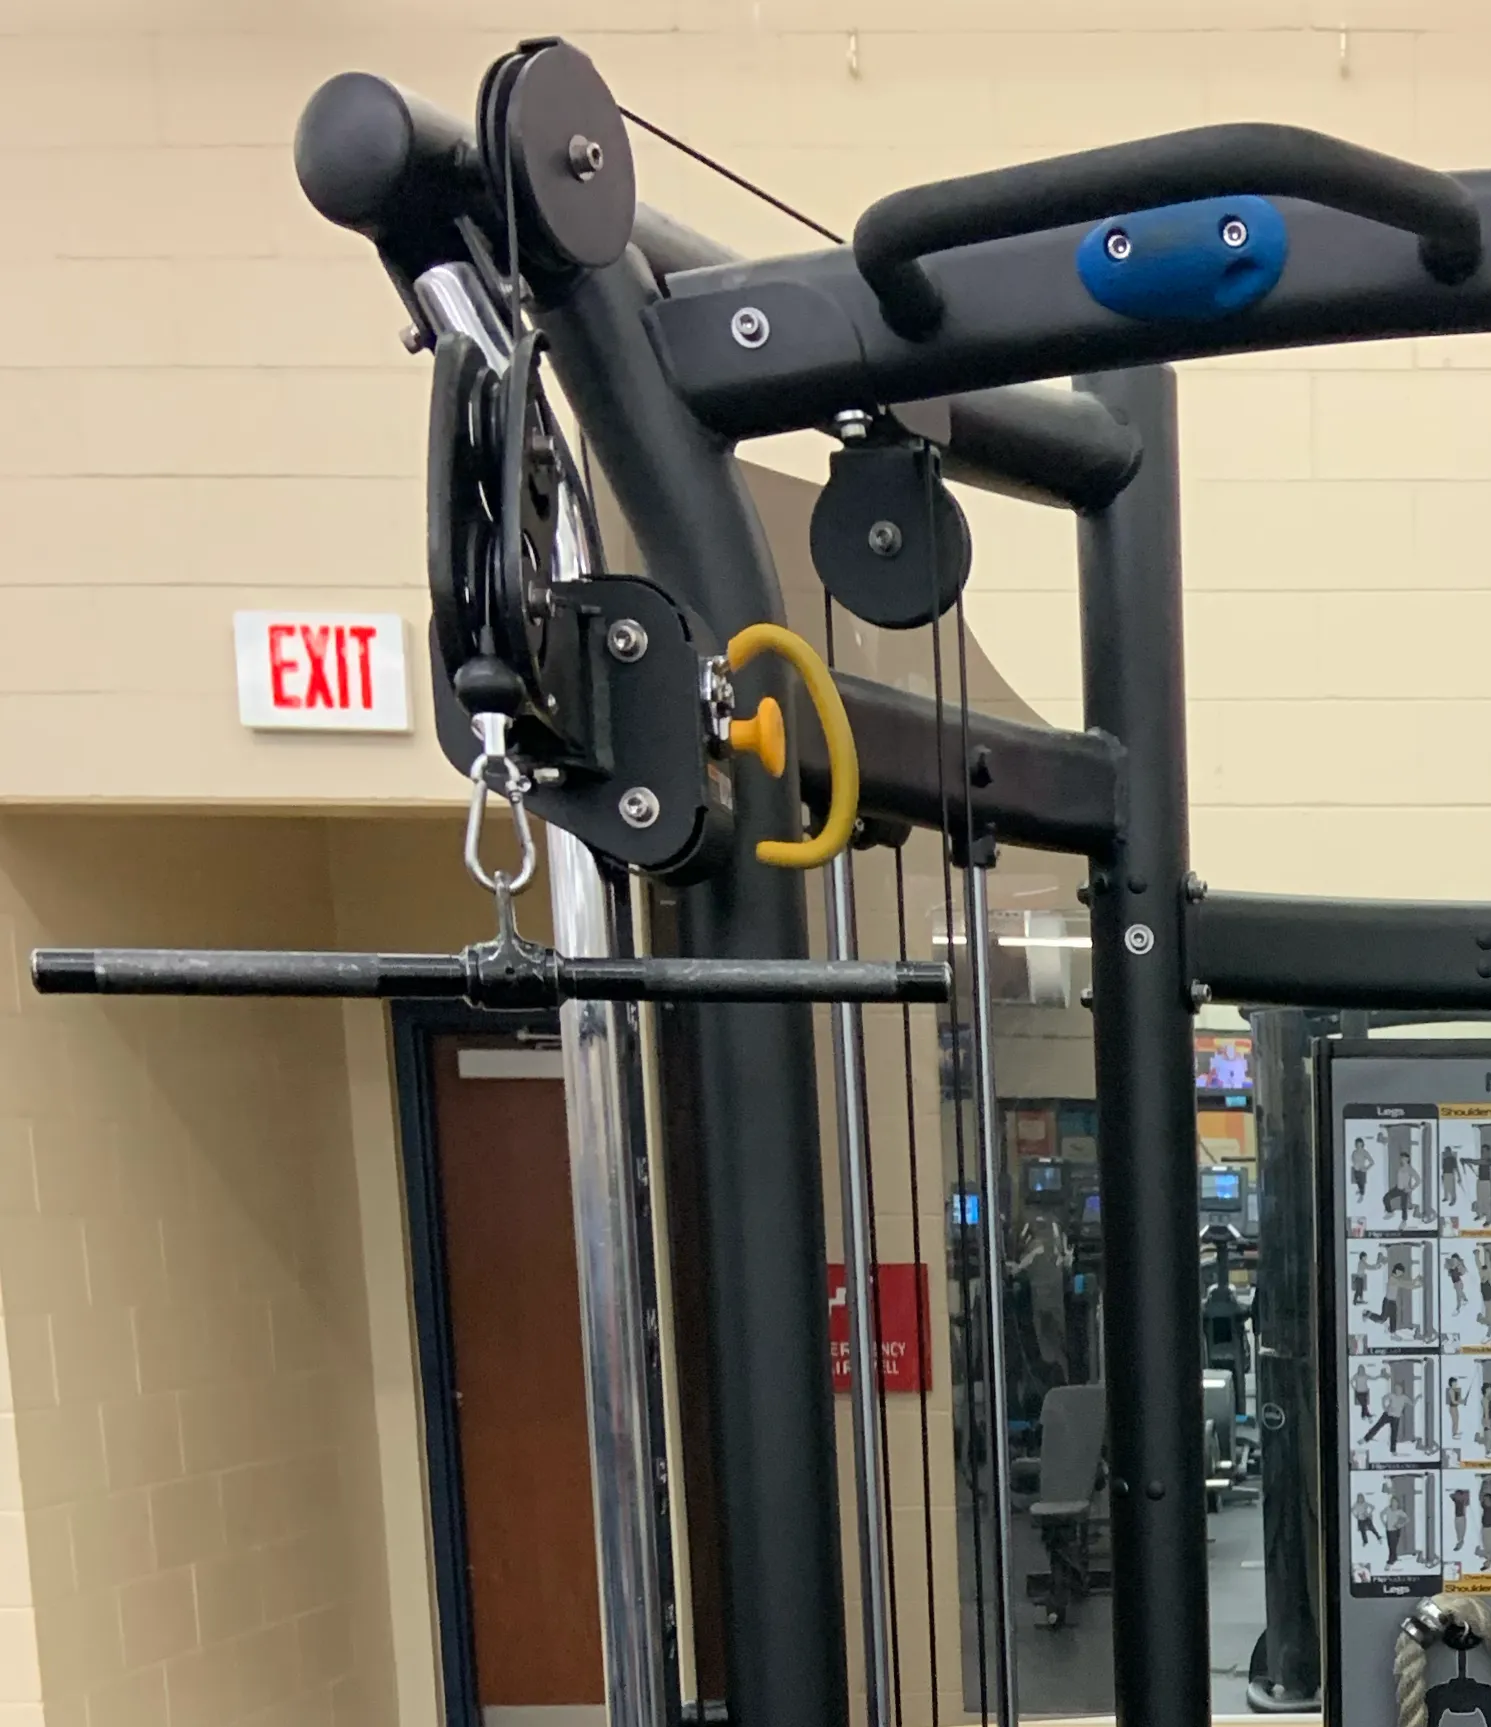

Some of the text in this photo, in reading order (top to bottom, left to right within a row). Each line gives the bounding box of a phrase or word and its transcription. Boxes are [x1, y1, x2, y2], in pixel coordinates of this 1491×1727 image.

[267, 624, 377, 711] EXIT
[1377, 1106, 1405, 1118] Legs
[1382, 1583, 1411, 1595] Legs
